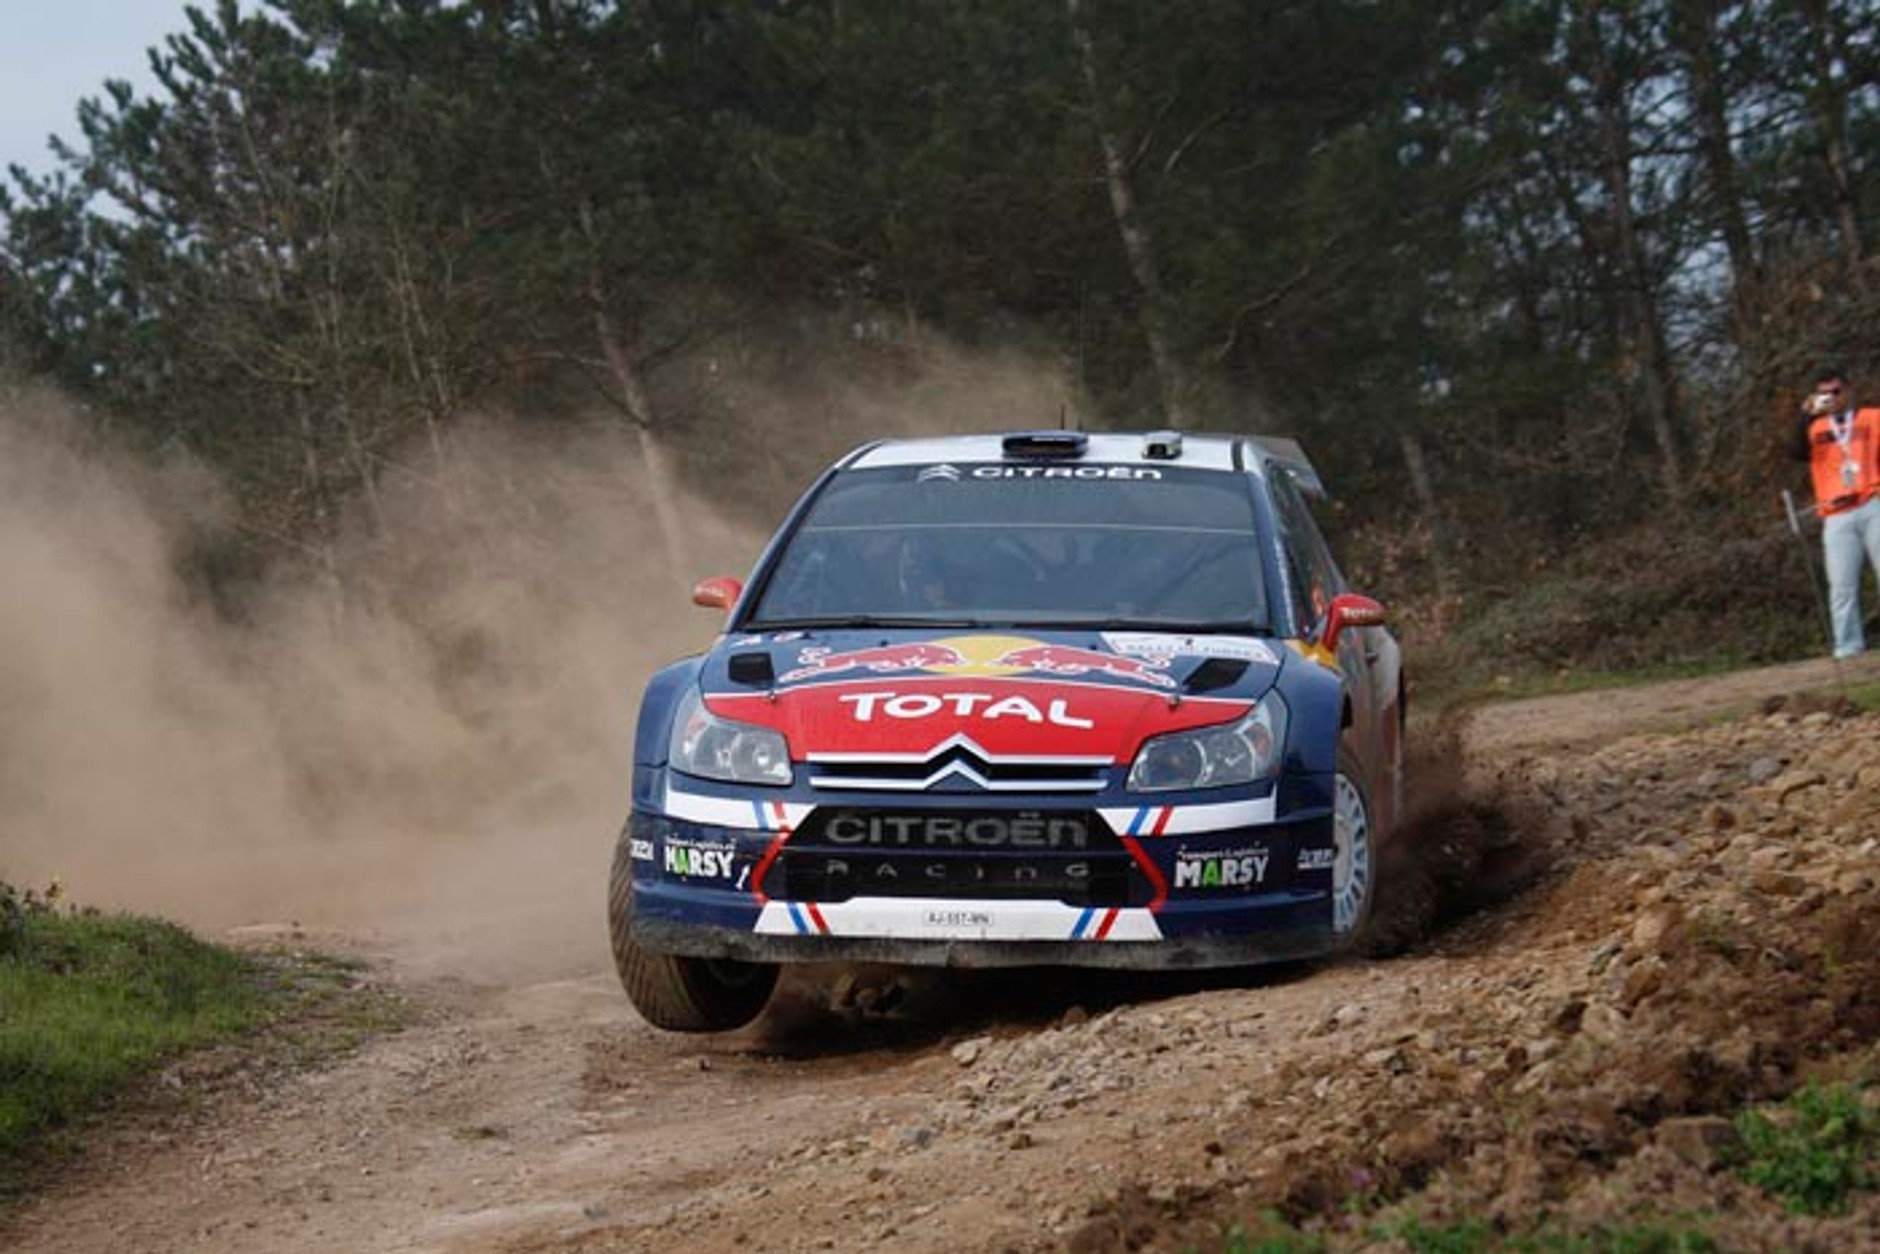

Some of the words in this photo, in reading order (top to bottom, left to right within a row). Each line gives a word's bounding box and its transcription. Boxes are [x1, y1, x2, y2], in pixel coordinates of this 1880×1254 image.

[838, 692, 1095, 730] TOTAL
[664, 845, 735, 878] MARSY
[1174, 856, 1269, 888] MARSY
